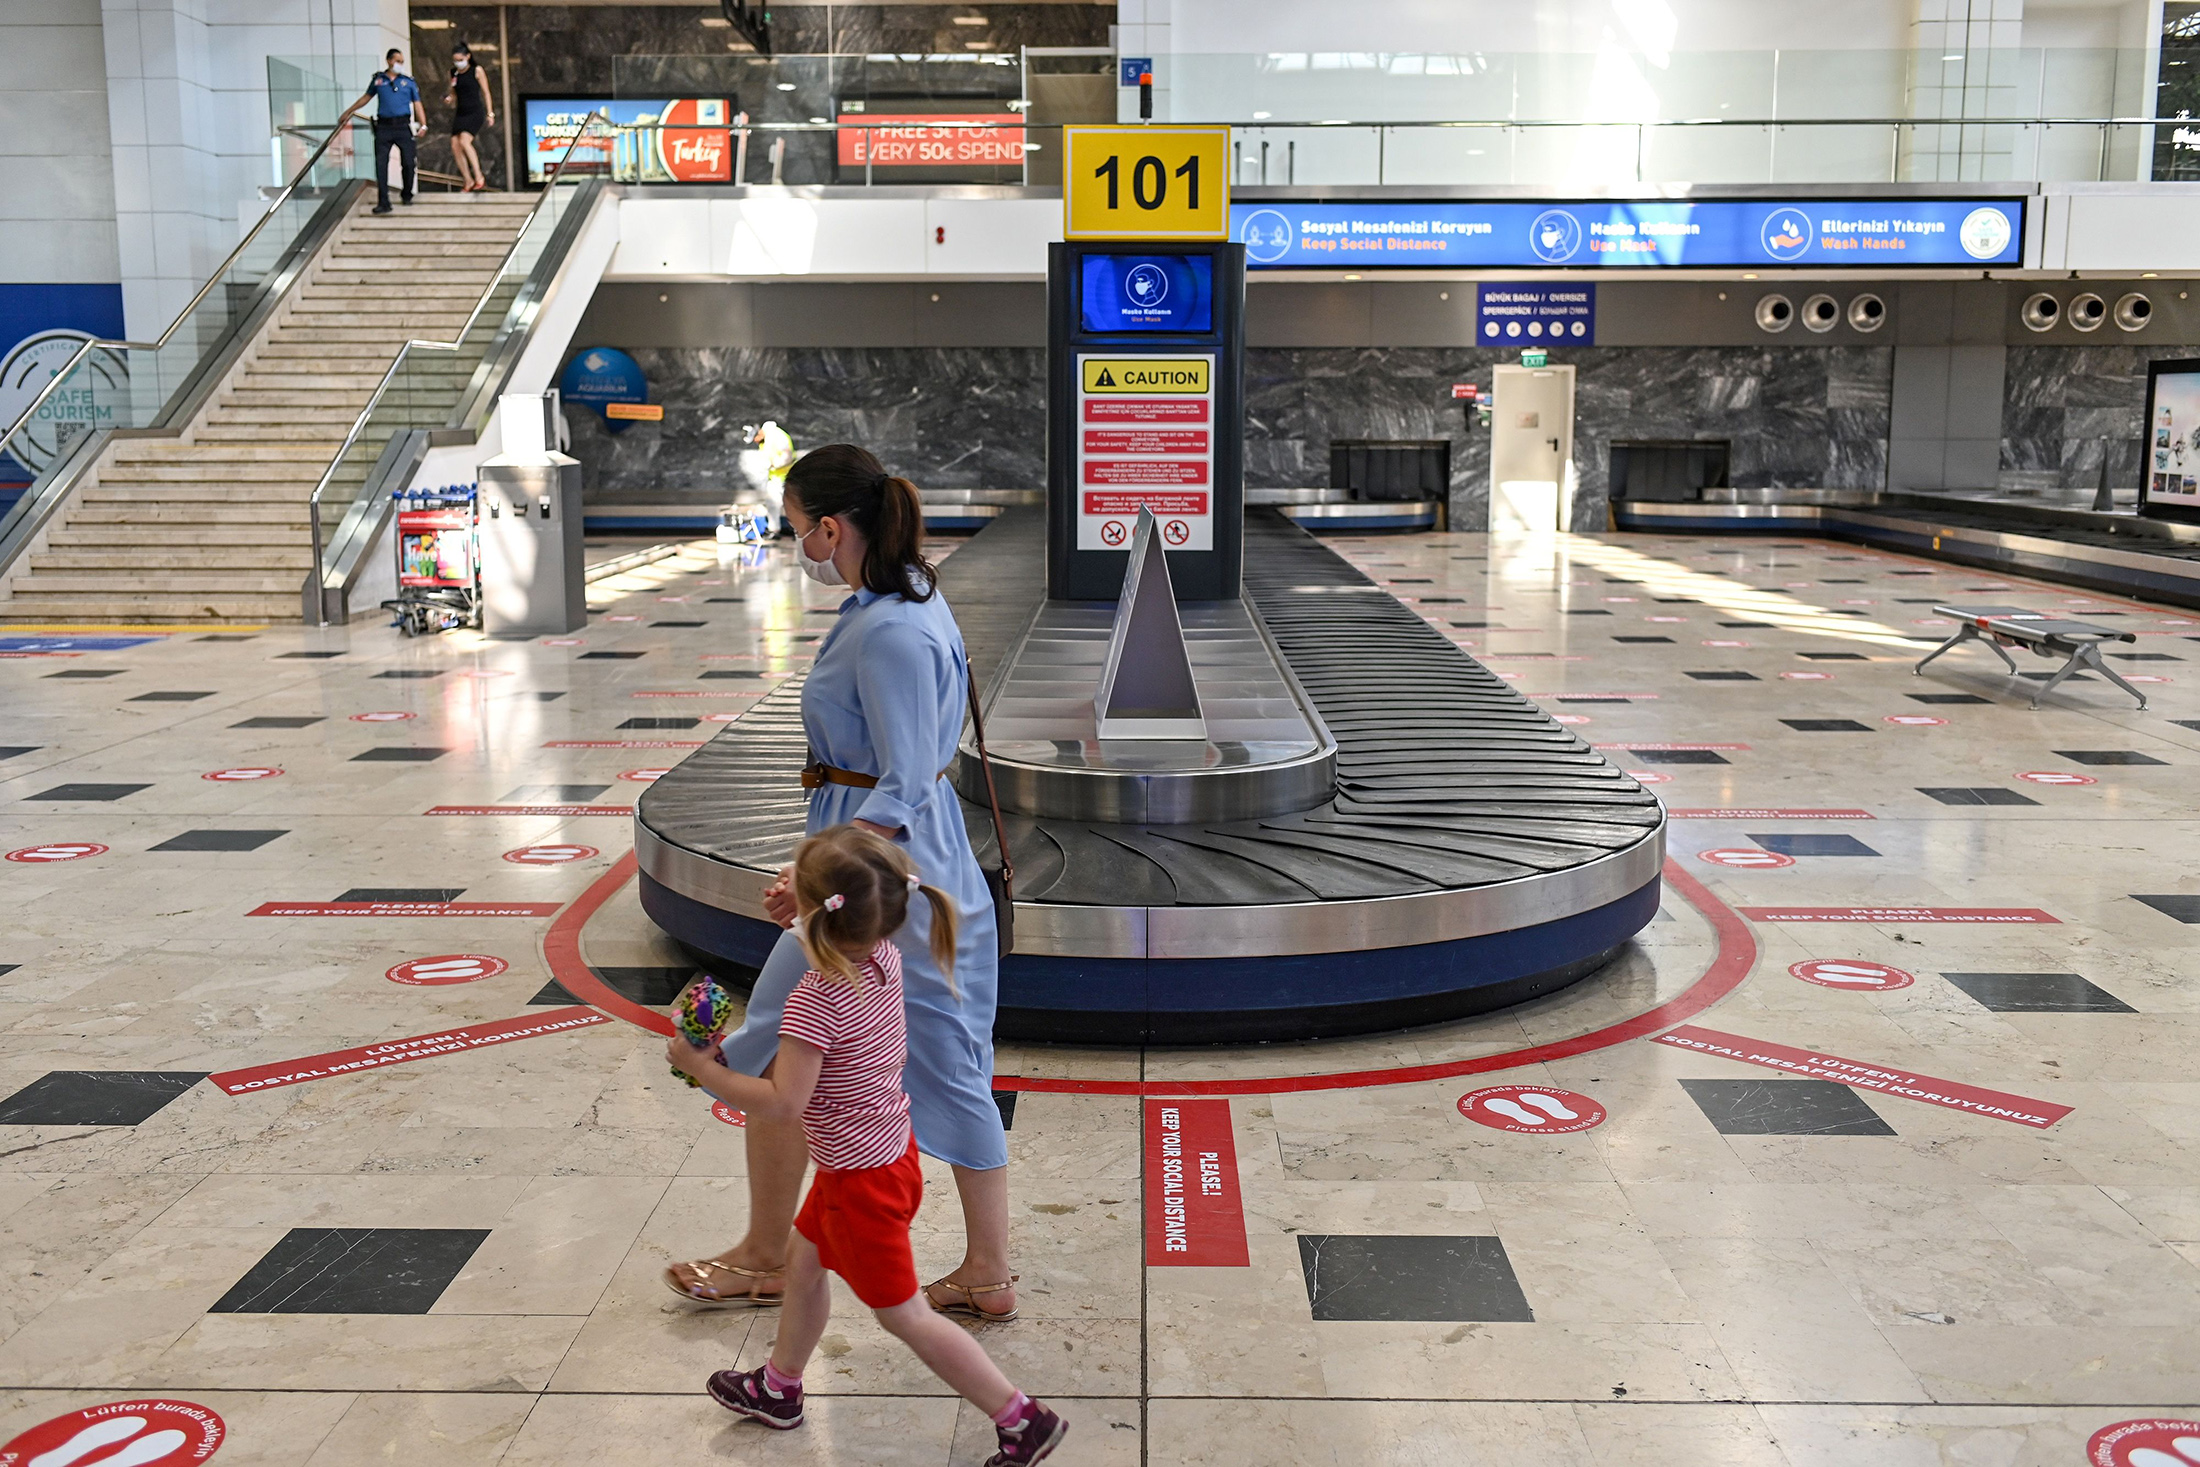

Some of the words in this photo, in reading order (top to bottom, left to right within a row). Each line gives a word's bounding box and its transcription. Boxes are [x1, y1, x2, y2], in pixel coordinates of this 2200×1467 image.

[571, 113, 588, 125] YO
[879, 121, 927, 139] FREE
[672, 136, 722, 172] Turkey
[854, 143, 916, 160] EVERY
[919, 142, 954, 160] 50€
[957, 142, 1025, 160] SPEND
[1095, 155, 1199, 210] 101
[1301, 220, 1348, 236] Sosyal
[1351, 220, 1428, 234] Mesafenizi
[1431, 220, 1492, 236] Koruyun
[1821, 220, 1889, 233] Ellerinizi
[1892, 220, 1945, 235] Yıkayın
[1301, 237, 1337, 251] Keep
[1340, 237, 1383, 250] Social
[1387, 237, 1447, 250] Distance
[1590, 239, 1617, 252] Use
[1620, 239, 1656, 252] Mask
[1821, 237, 1858, 249] Wash
[1862, 237, 1906, 249] Hands
[1523, 356, 1546, 366] EXIT
[1124, 371, 1199, 385] CAUTION
[32, 405, 112, 420] OURISM
[228, 1069, 328, 1092] SOSYAL
[327, 1041, 467, 1073] MESAFENİZİ
[468, 1015, 604, 1046] KORUYUNUZ
[1661, 1034, 1745, 1060] SOSYAL
[1750, 1053, 1888, 1089] MESAFENİZİ
[1887, 1085, 2049, 1125] KORUYUNUZ
[1474, 1085, 1513, 1098] burada
[1515, 1085, 1570, 1097] bekleyin
[716, 1108, 740, 1124] Please
[1161, 1107, 1180, 1130] KEEP
[1557, 1120, 1592, 1132] stand
[1586, 1111, 1602, 1125] here
[1161, 1131, 1182, 1157] YOUR
[1162, 1158, 1184, 1196] SOCIAL
[1164, 1197, 1188, 1252] DISTANCE
[83, 1403, 149, 1419] Lütfen
[154, 1402, 207, 1421] burada
[193, 1418, 221, 1458] bekleyin
[2100, 1422, 2153, 1443] burada
[2154, 1421, 2200, 1432] bekl
